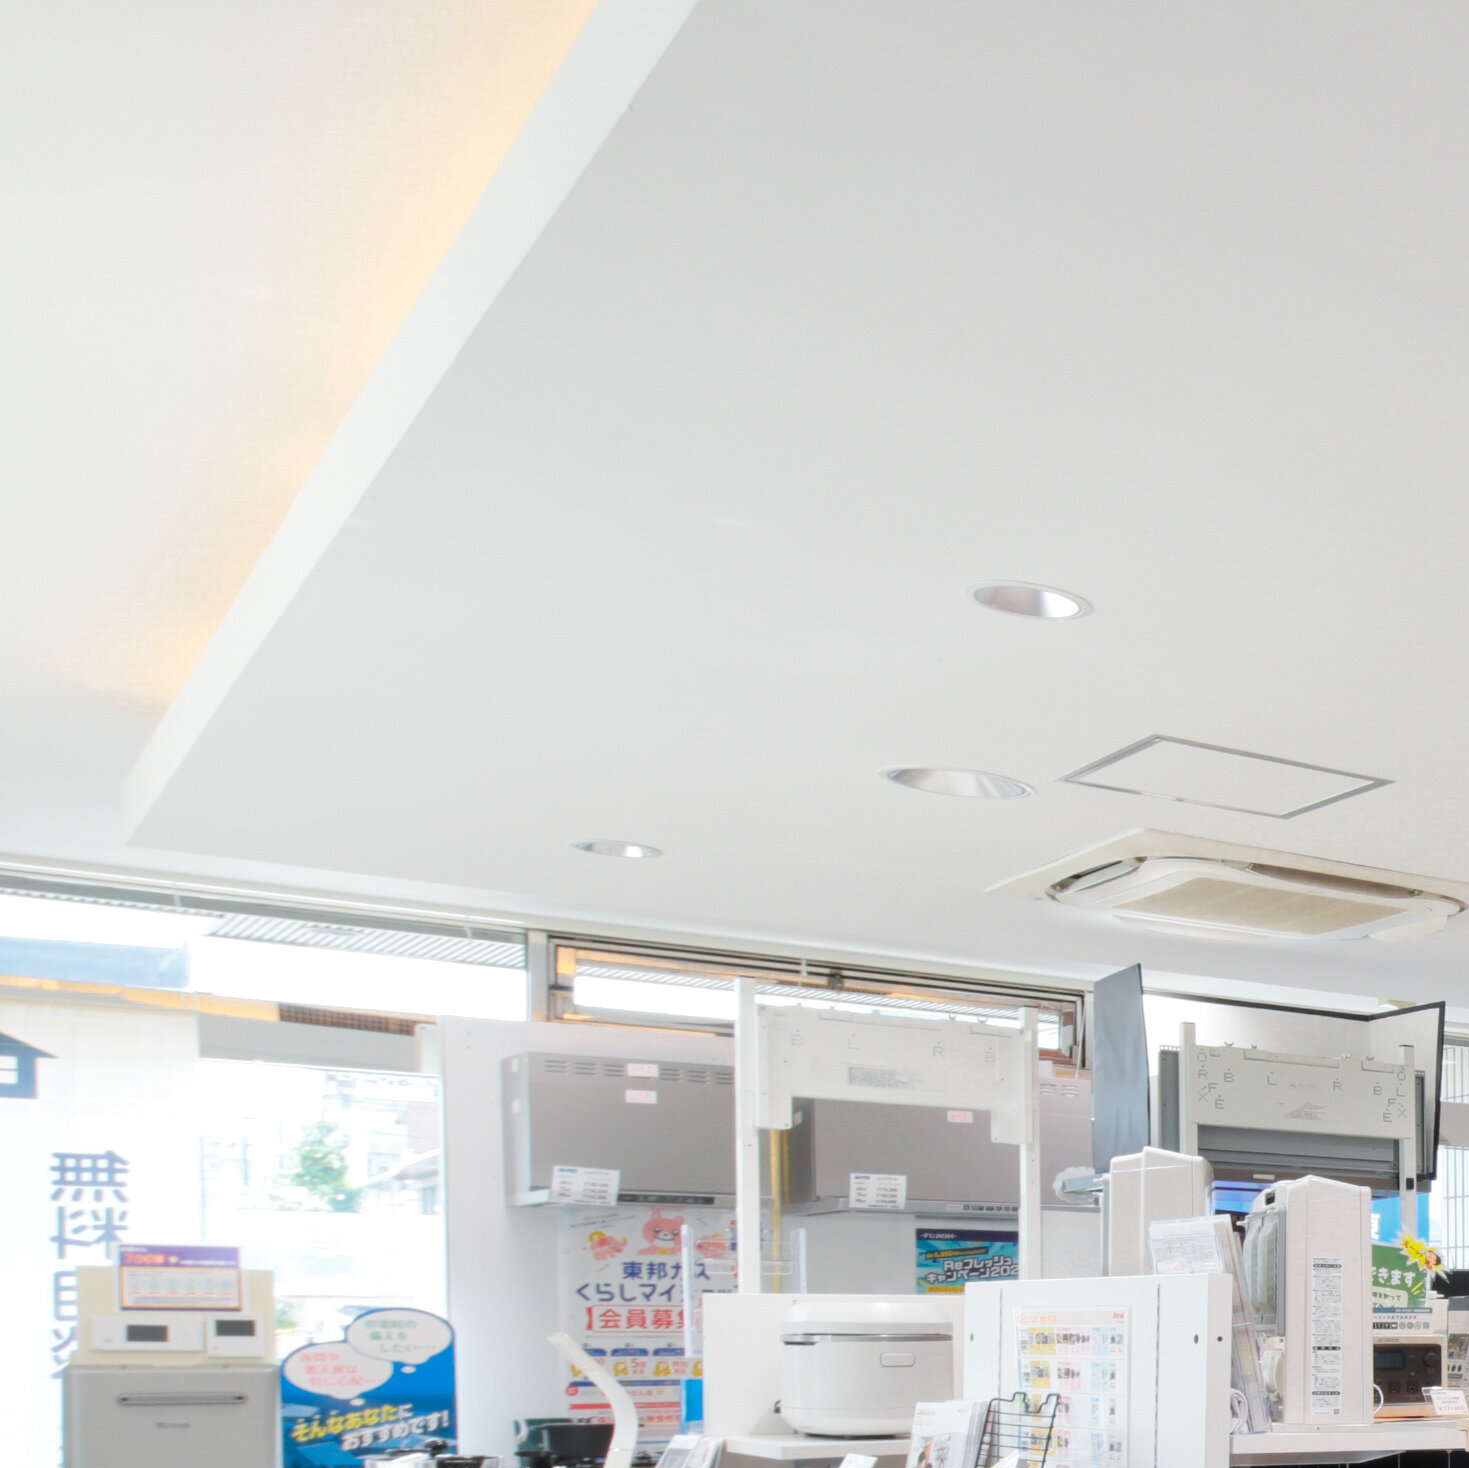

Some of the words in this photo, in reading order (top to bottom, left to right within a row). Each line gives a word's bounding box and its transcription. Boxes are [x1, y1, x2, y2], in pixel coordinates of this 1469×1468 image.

[944, 1255, 1012, 1271] Reフレッシュ
[292, 1403, 414, 1443] そんなあなたに
[341, 1409, 450, 1451] おすすめです!
